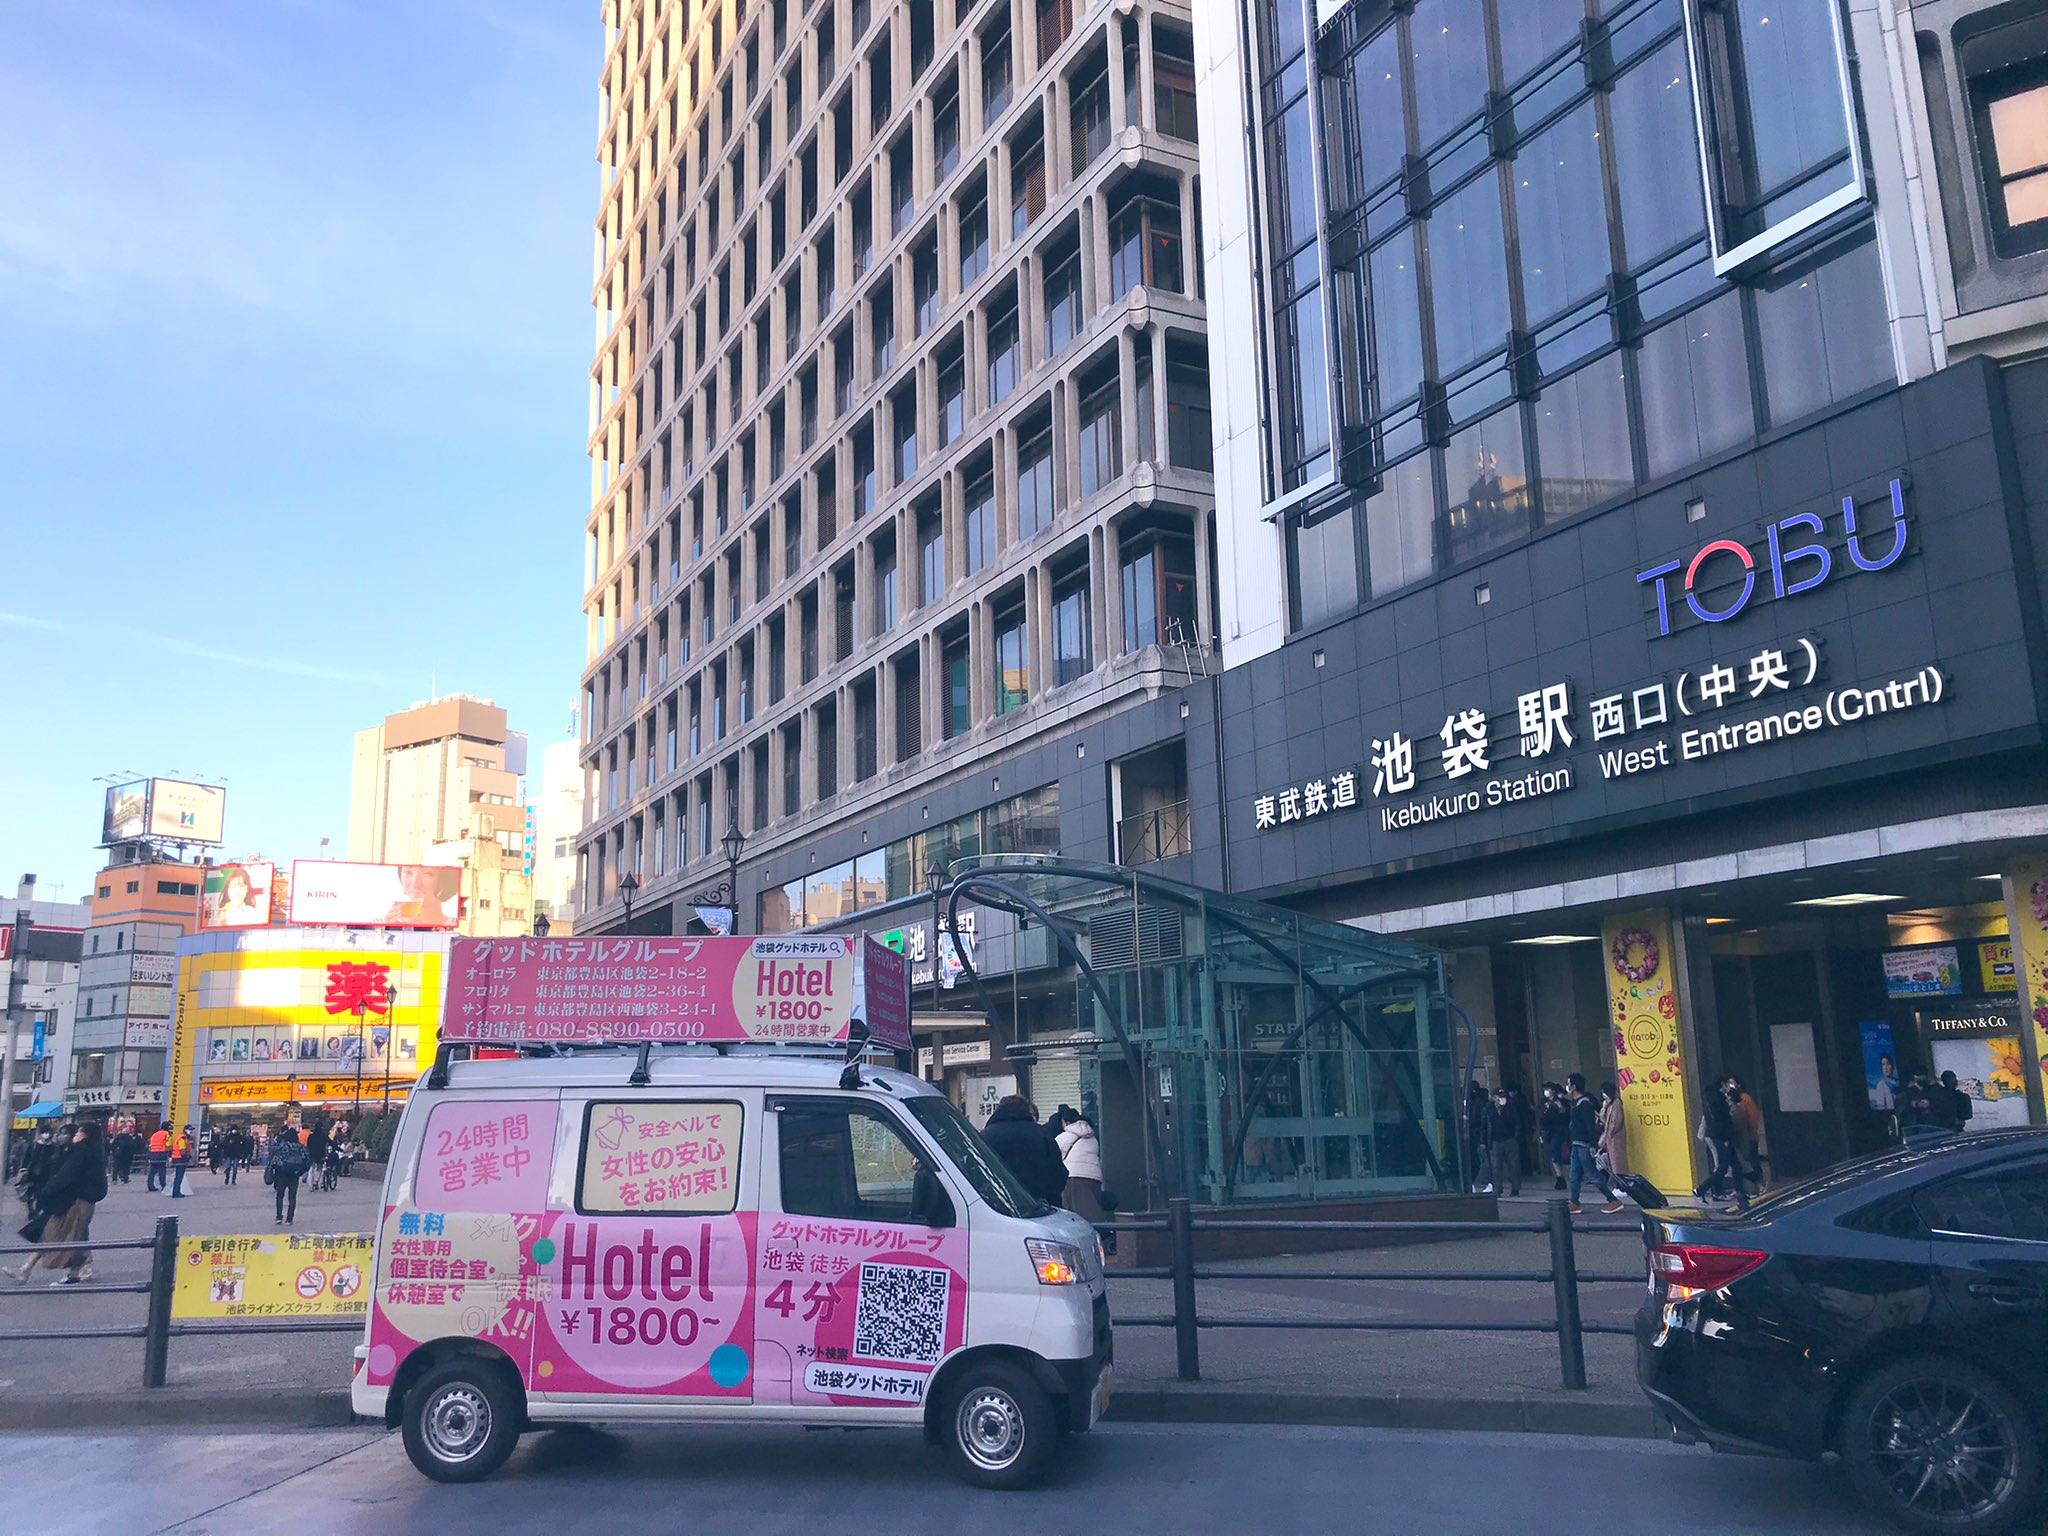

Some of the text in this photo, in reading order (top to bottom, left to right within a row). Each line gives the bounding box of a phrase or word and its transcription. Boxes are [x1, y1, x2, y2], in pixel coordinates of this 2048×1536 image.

[1636, 478, 1909, 638] TOBU
[1369, 681, 1576, 800] 池袋駅
[1598, 743, 1670, 780] West
[1253, 771, 1358, 831] 東武鉄道
[1380, 766, 1572, 832] Ikebukuro Station
[307, 890, 337, 899] KIRIN
[473, 940, 704, 965] グッドホテルグループ
[755, 942, 828, 954] 池袋グッドホテル
[465, 966, 708, 982] オーロラ 東京都豊島区池袋2-18-2
[756, 960, 833, 997] Hotel
[325, 961, 390, 1016] 薬
[463, 984, 706, 999] フロリダ 東京都豊島区池袋2-36-4
[461, 1002, 717, 1018] サンマルコ 東京都豊島区西池袋3-24-1
[754, 1023, 831, 1038] 24時間営業中
[982, 1085, 997, 1101] JR
[638, 1114, 722, 1140] 安全ベルで
[1637, 1114, 1670, 1127] TOBU
[437, 1114, 529, 1157] 24時間
[439, 1145, 531, 1193] 営業中
[601, 1137, 726, 1182] 女性の安心
[399, 1212, 446, 1236] 無料
[469, 1215, 538, 1242] メイク
[772, 1221, 945, 1253] グッドホテルグループ
[390, 1240, 452, 1256] 女性専用
[561, 1222, 714, 1302] Hotel
[387, 1283, 465, 1305] 休憩室で
[764, 1279, 843, 1323] 4分
[796, 1344, 849, 1361] ネット検索
[813, 1369, 923, 1397] 池袋グッドホテル
